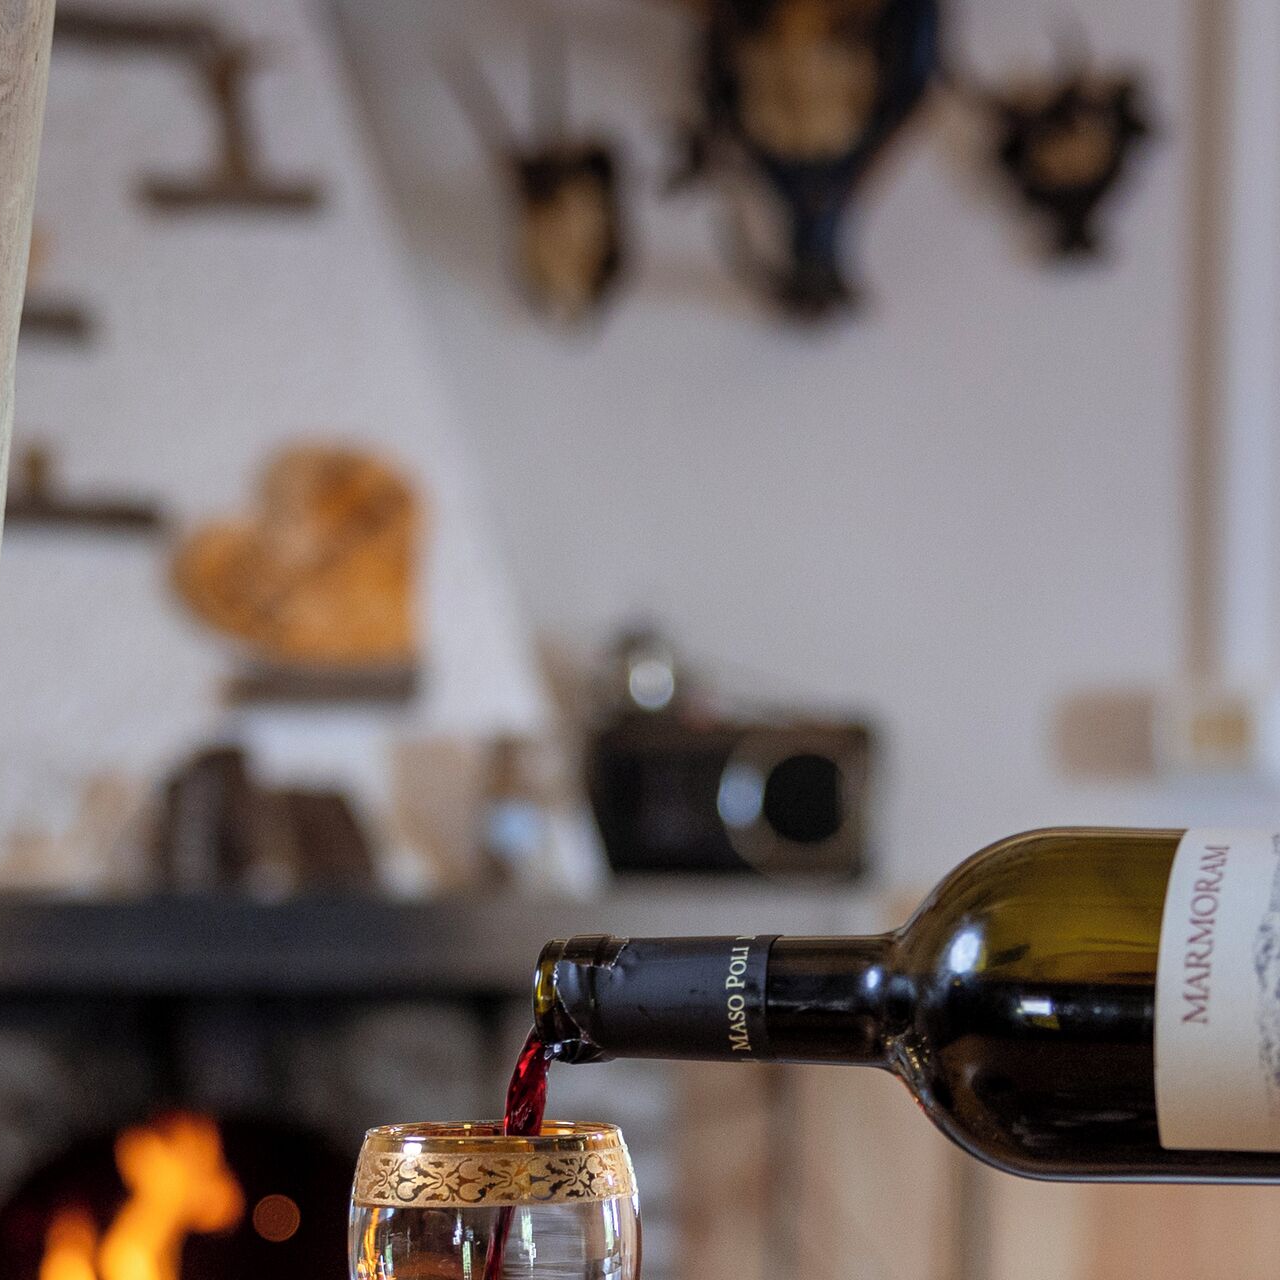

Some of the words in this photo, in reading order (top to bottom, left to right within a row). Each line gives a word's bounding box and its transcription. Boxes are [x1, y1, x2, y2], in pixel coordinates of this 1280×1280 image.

[1181, 845, 1231, 1024] MARMORAM
[725, 946, 750, 989] POLI
[727, 995, 752, 1051] MASO
